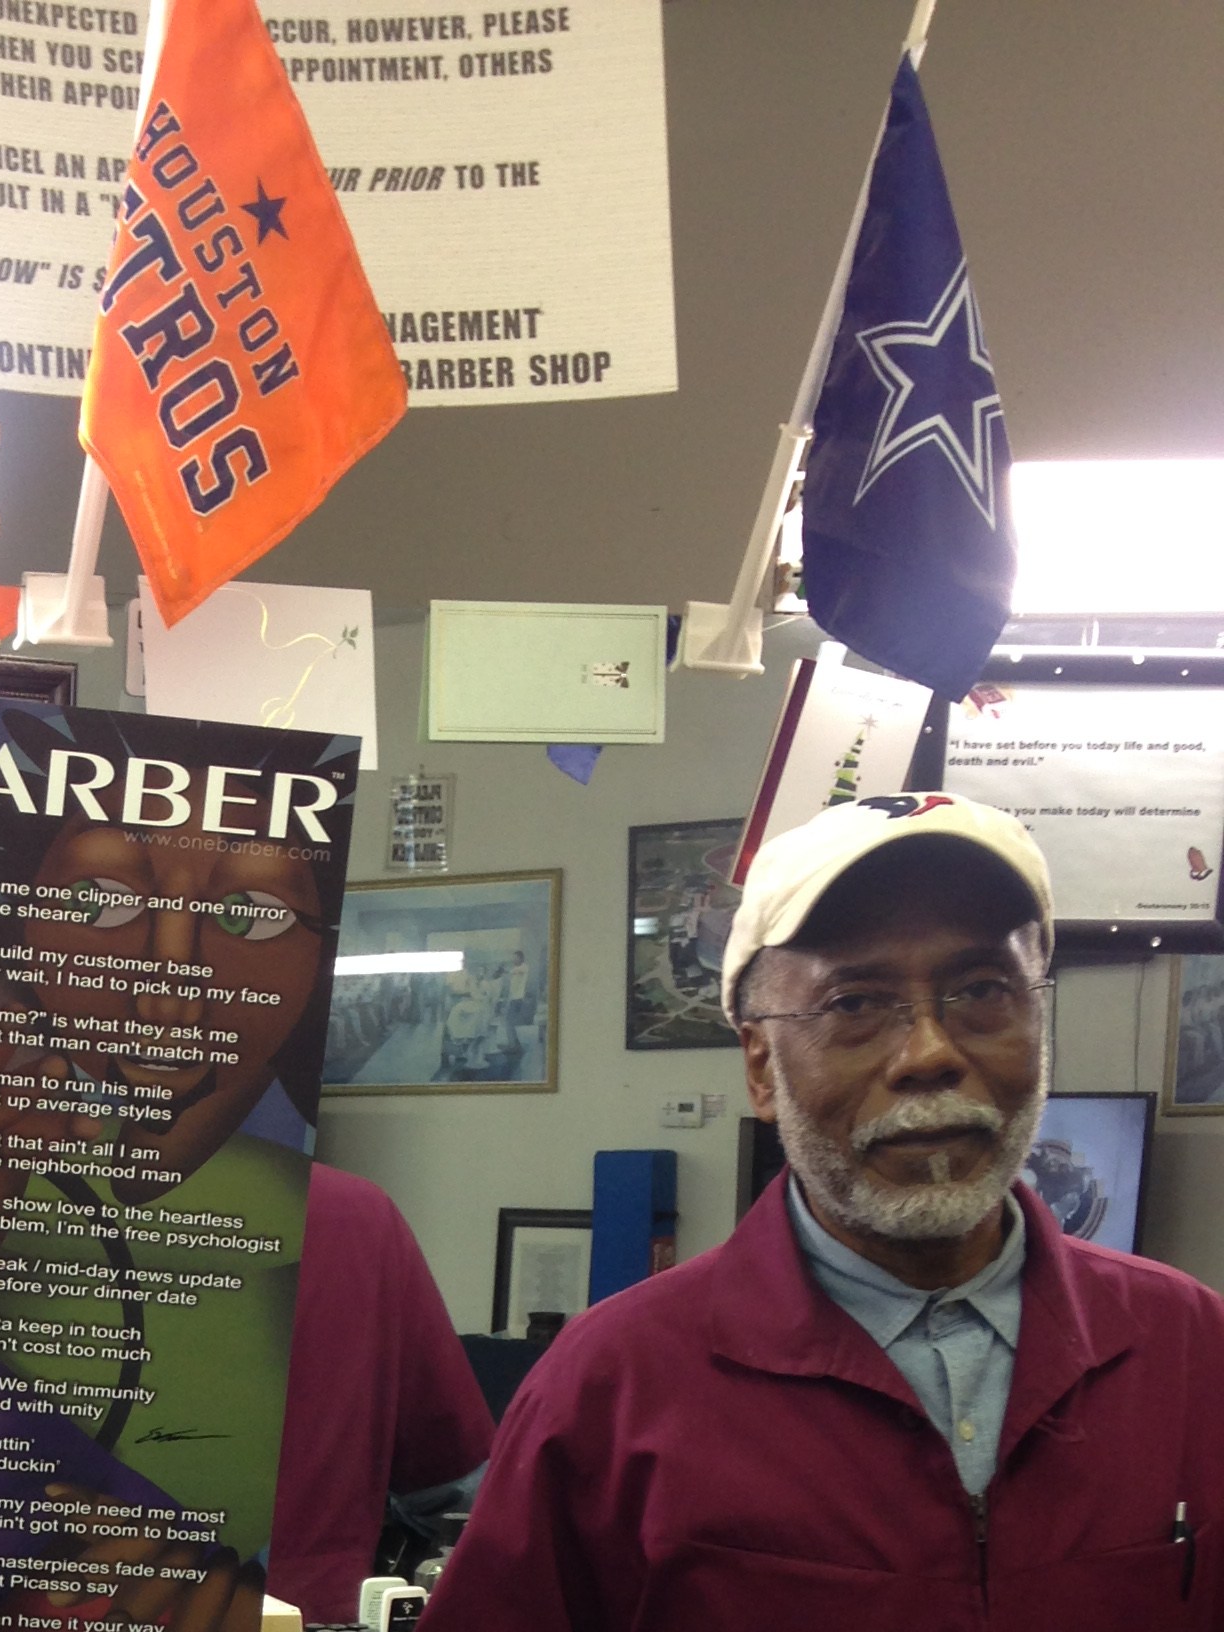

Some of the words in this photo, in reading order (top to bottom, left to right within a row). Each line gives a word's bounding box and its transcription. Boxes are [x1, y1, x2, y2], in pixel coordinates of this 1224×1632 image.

[265, 18, 337, 45] CCUR,
[347, 15, 473, 43] HOWEVER,
[484, 7, 571, 39] PLEASE
[47, 41, 93, 71] YOU
[459, 48, 554, 79] OTHERS
[55, 152, 86, 179] AN
[368, 166, 446, 193] PRIOR
[454, 163, 485, 190] TO
[495, 161, 541, 188] THE
[41, 188, 65, 214] IN
[75, 191, 91, 216] A
[137, 99, 302, 398] HOUSTON
[57, 263, 84, 290] IS
[382, 308, 541, 344] NAGEMENT
[99, 179, 270, 517] TROS
[530, 351, 613, 385] SHOP
[948, 757, 983, 766] death
[986, 757, 1009, 766] and
[963, 740, 992, 750] have
[996, 740, 1016, 750] set
[1019, 740, 1057, 750] before
[1061, 742, 1083, 752] you
[1086, 742, 1121, 753] today
[1124, 741, 1143, 750] life
[1147, 742, 1169, 750] and
[1173, 742, 1206, 753] good,
[1015, 808, 1036, 818] you
[1039, 806, 1073, 816] make
[1076, 806, 1111, 818] today
[1114, 806, 1136, 816] will
[1139, 806, 1201, 817] determine
[123, 828, 332, 863] www.onebarber.com
[0, 881, 30, 896] me
[36, 885, 72, 900] one
[78, 887, 143, 908] clipper
[148, 894, 184, 911] and
[189, 900, 225, 916] one
[230, 901, 288, 921] mirror
[8, 1155, 136, 1179] neighborhood
[141, 1167, 182, 1184] man
[33, 1378, 68, 1396] find
[72, 1382, 155, 1405] immunity
